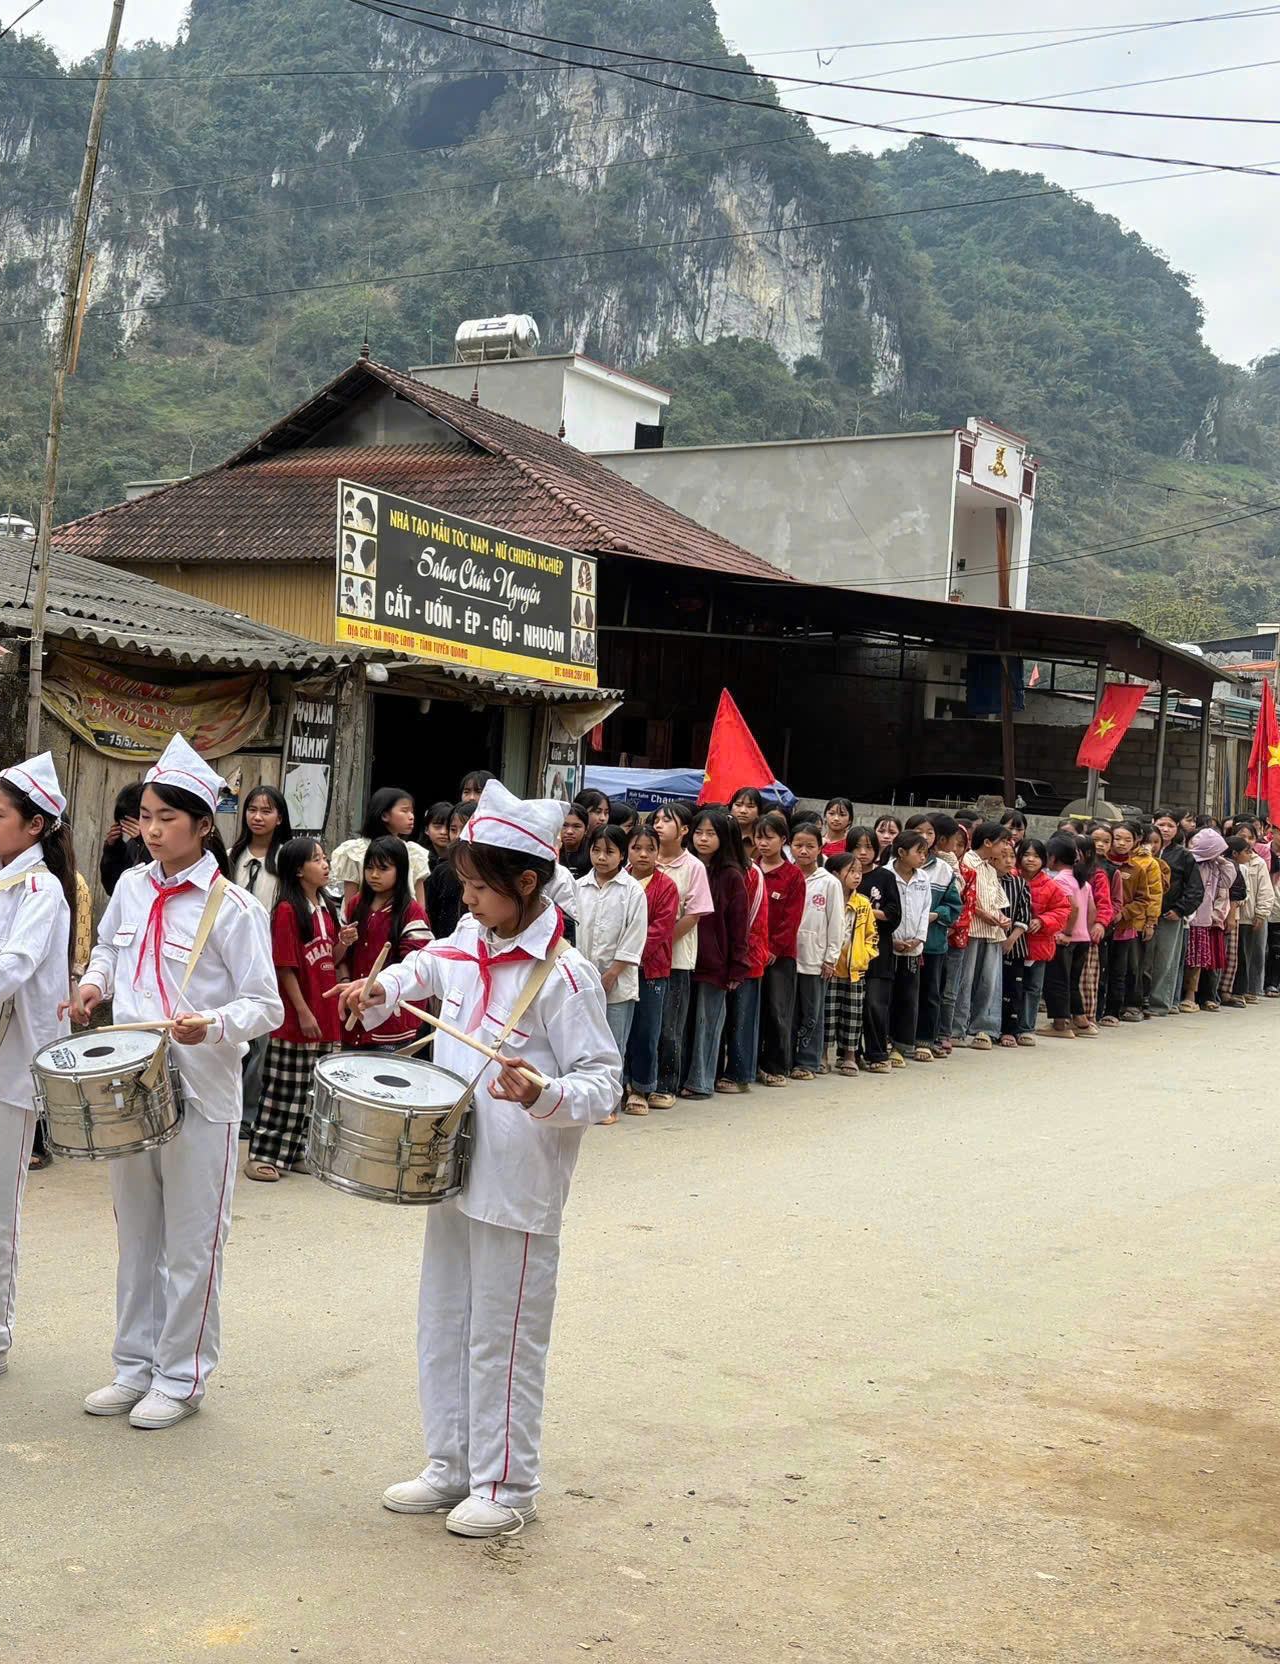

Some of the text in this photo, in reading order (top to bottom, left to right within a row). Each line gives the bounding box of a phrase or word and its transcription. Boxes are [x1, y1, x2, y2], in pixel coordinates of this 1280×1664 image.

[390, 509, 410, 531] NHÀ
[411, 516, 430, 538] TẠO
[431, 518, 450, 544] MẪU
[452, 528, 469, 549] TÓC
[470, 535, 489, 555] NAM
[538, 556, 564, 578] NGHIỆP
[417, 546, 457, 583] Salon
[459, 558, 491, 592] Châu
[385, 584, 412, 619] CẮT
[425, 595, 452, 629] UỐN
[464, 606, 481, 635] ÉP
[492, 614, 513, 647] GỘI
[523, 624, 565, 656] NHUỘM
